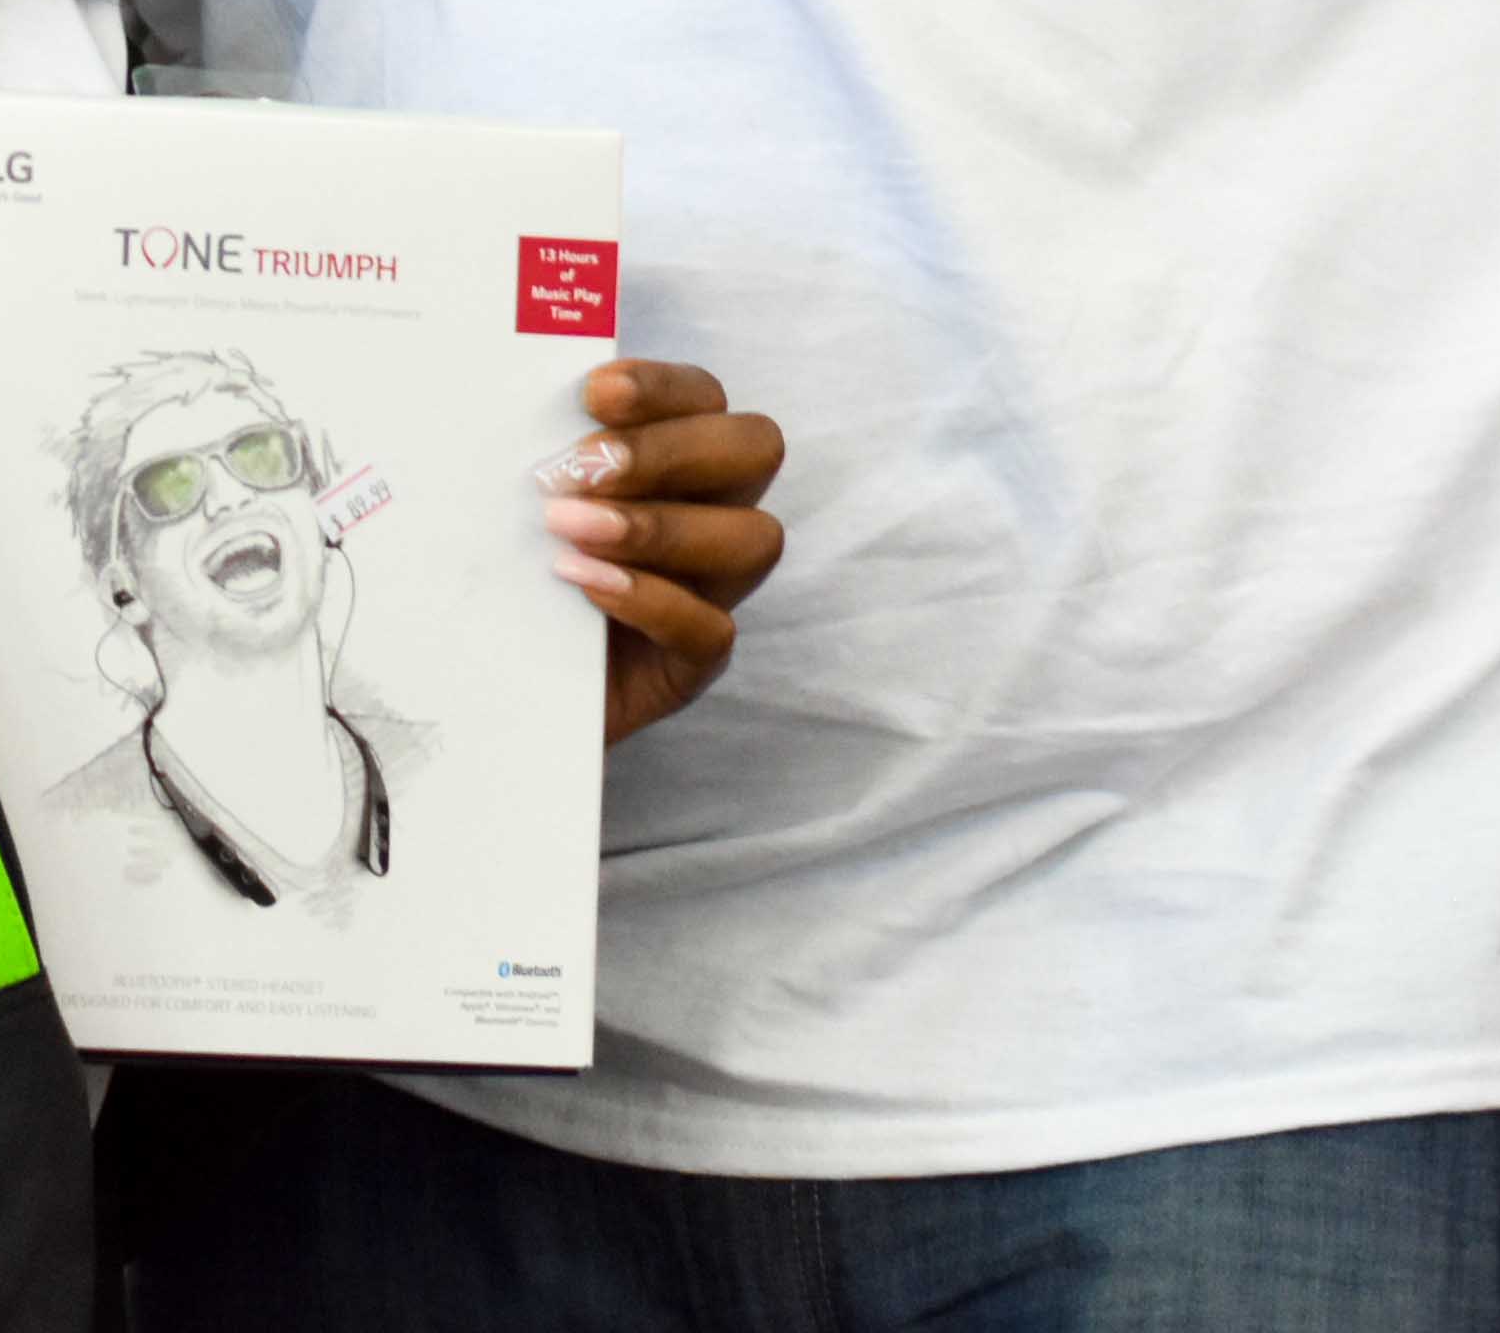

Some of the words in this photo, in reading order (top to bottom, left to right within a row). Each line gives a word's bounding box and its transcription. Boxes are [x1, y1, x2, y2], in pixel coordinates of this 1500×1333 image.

[113, 225, 246, 275] TONE
[252, 247, 400, 283] TRIUMPH
[539, 247, 556, 263] 13
[558, 249, 600, 266] Hours
[559, 268, 576, 282] of
[531, 284, 571, 302] Music
[573, 287, 603, 307] Play
[549, 304, 583, 322] Time
[511, 963, 562, 978] Bluetooth
